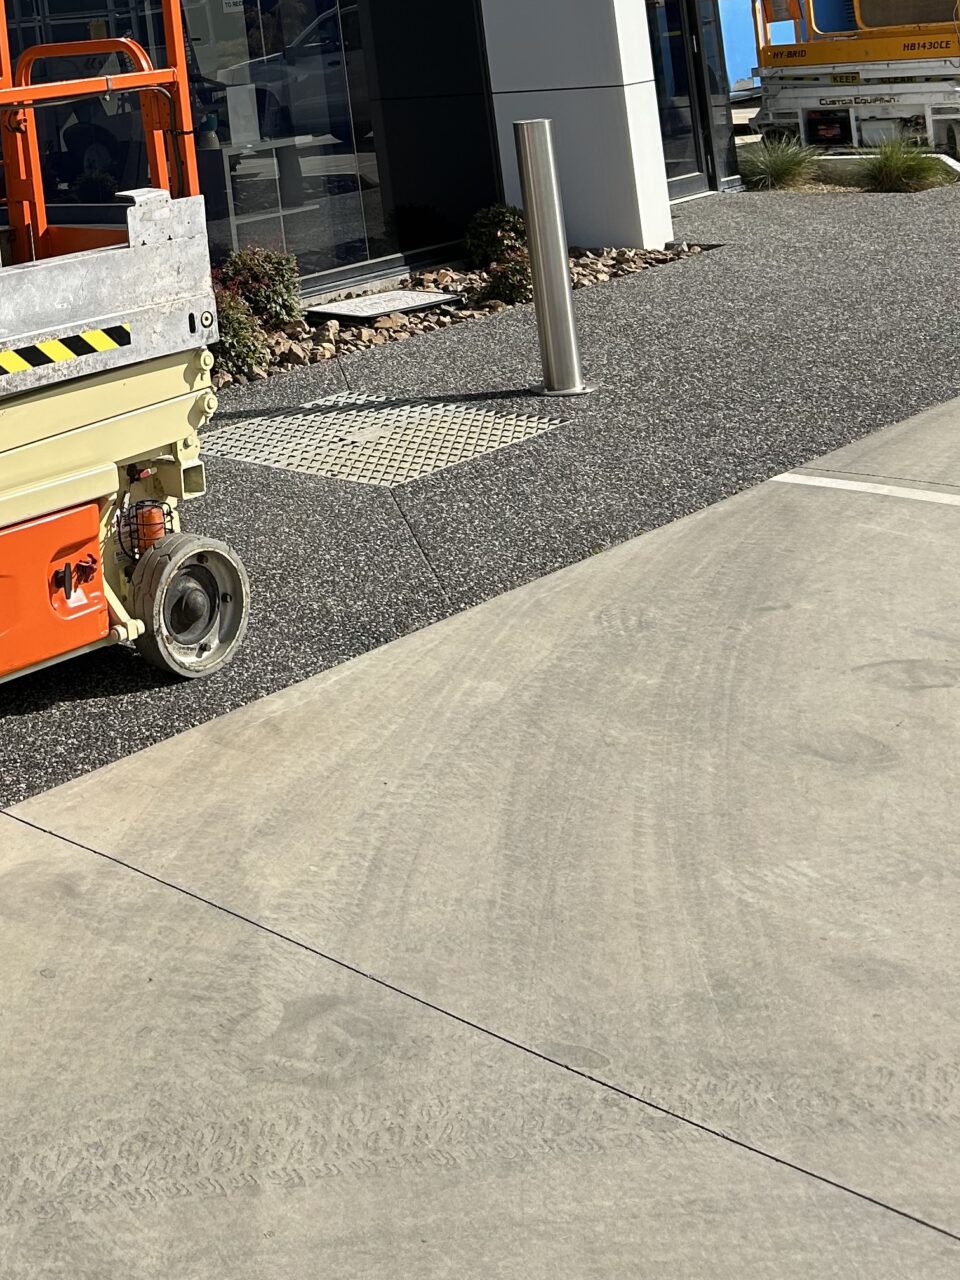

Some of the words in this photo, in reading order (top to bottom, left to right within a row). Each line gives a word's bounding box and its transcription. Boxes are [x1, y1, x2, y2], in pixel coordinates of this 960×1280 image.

[903, 40, 951, 51] HB1430CE
[772, 49, 807, 59] HY-BRID
[832, 75, 857, 84] KEEP
